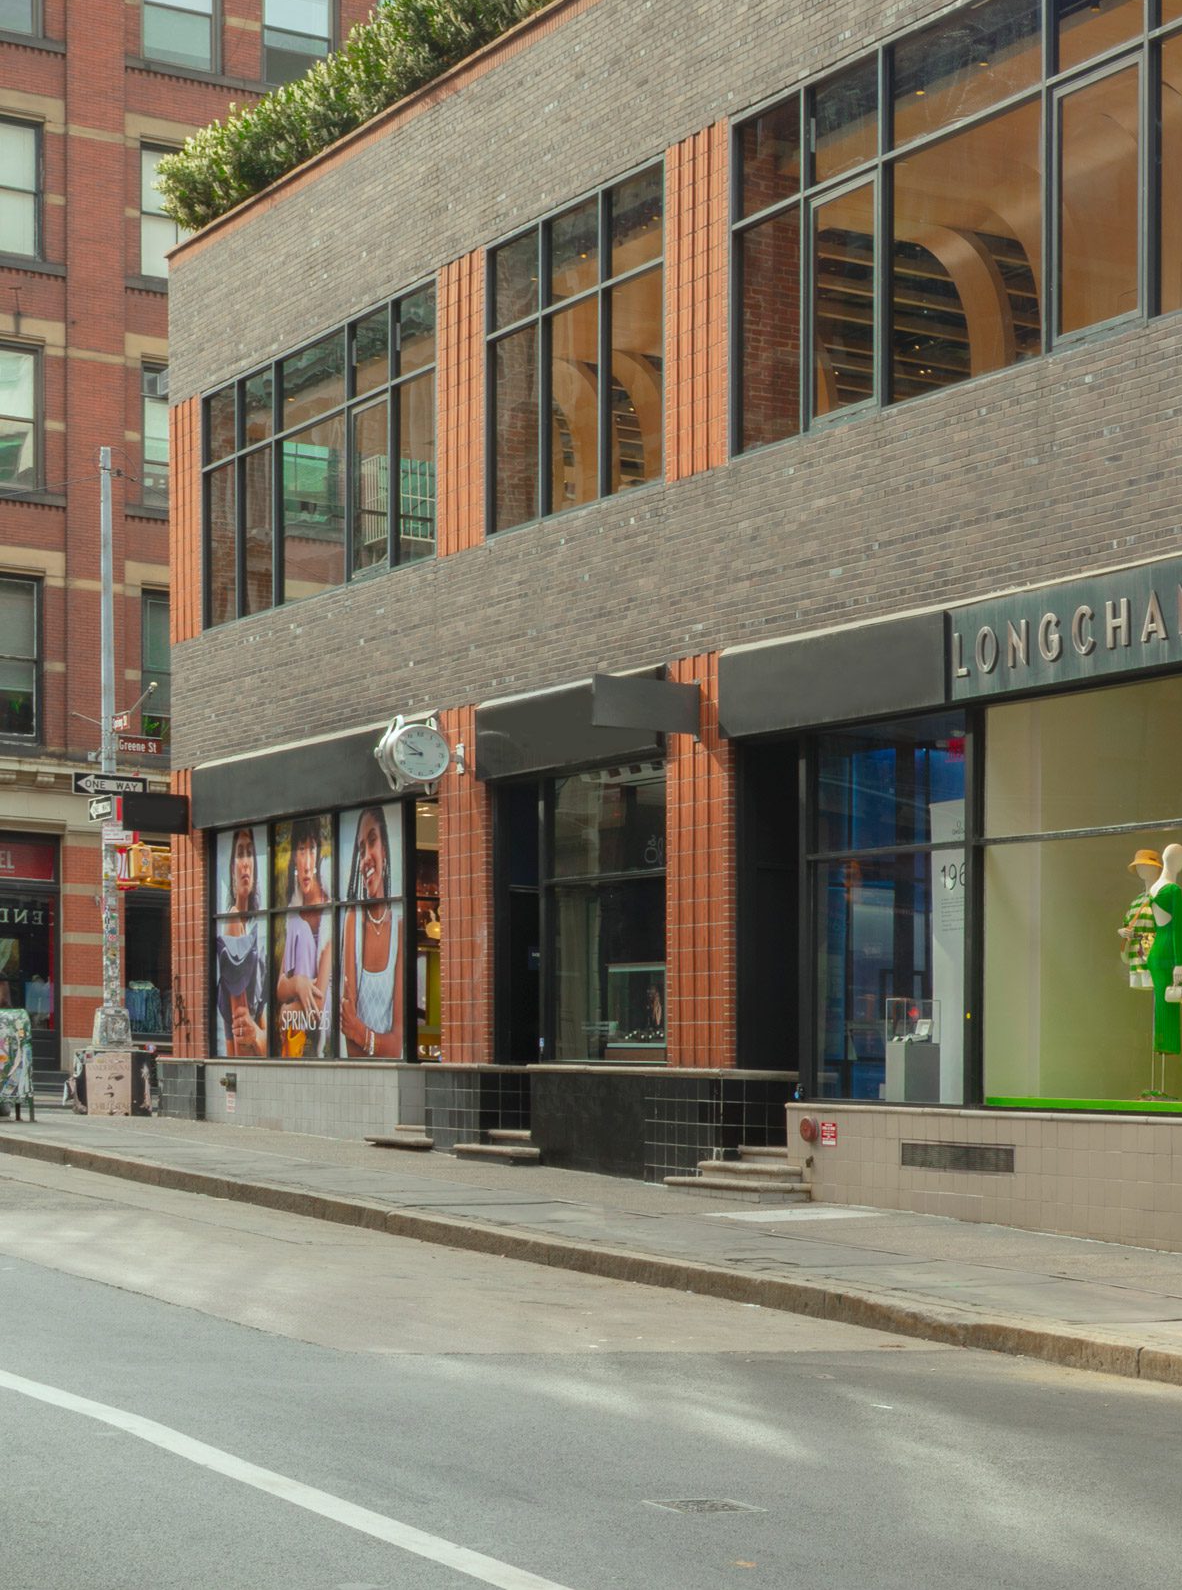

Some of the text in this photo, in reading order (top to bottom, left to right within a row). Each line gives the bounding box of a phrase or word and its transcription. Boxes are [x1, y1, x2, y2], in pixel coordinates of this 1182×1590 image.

[119, 739, 157, 753] Greene St
[85, 779, 138, 792] ONE WAY
[281, 1009, 317, 1030] SPRING
